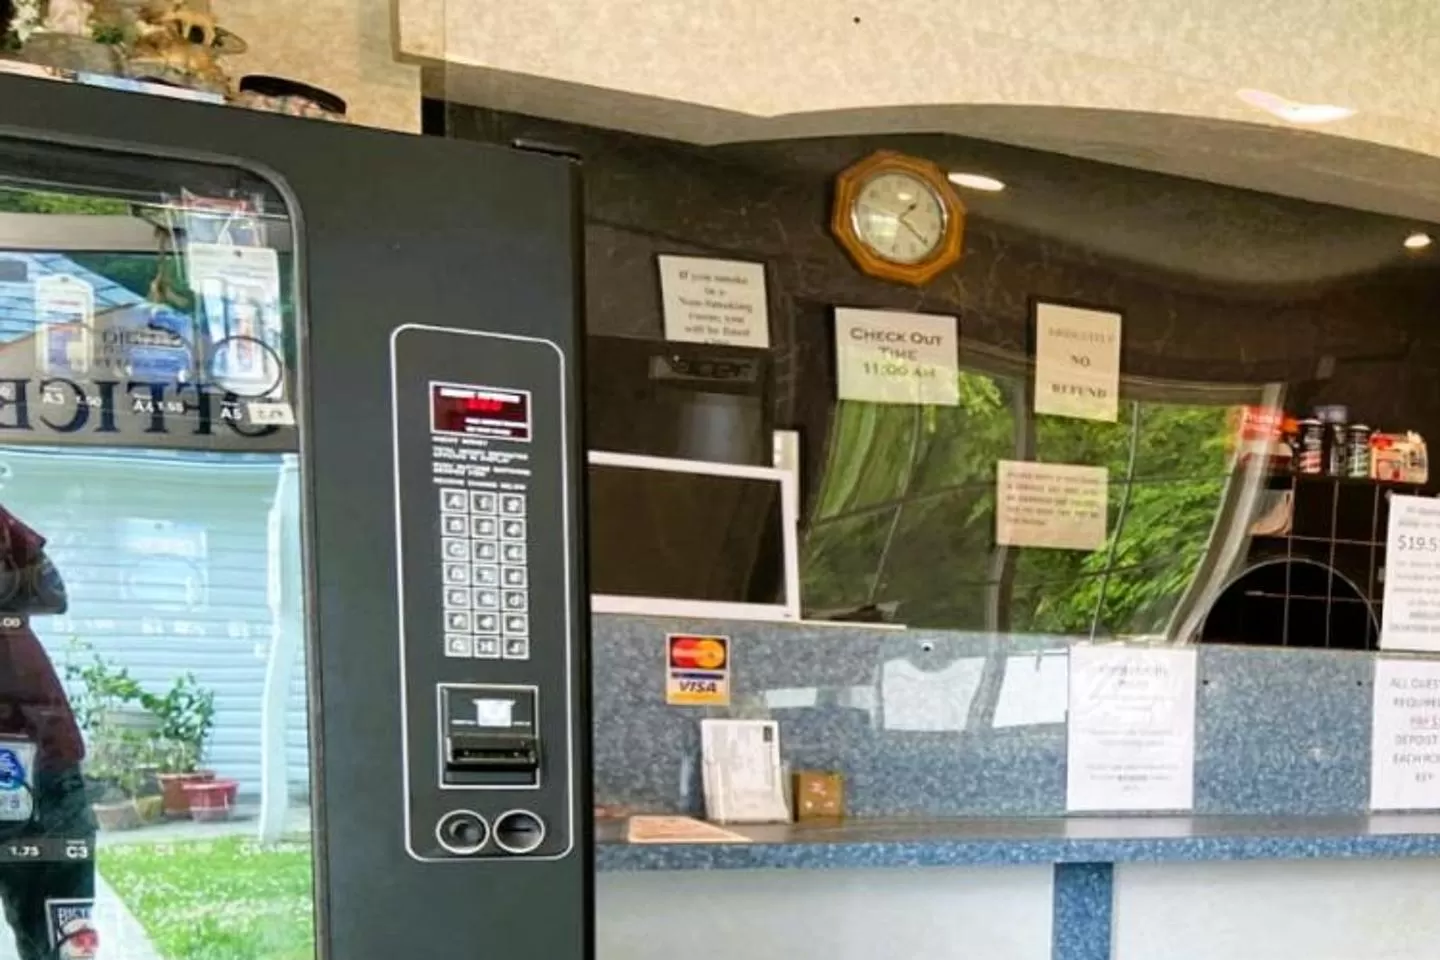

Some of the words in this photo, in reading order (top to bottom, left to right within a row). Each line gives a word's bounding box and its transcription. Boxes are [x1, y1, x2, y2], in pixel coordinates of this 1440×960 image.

[849, 327, 905, 343] CHECK
[910, 331, 943, 346] OUT
[878, 345, 918, 361] TIME
[1070, 354, 1091, 368] NO
[863, 362, 908, 376] 11:00
[1051, 383, 1107, 398] REFUND
[678, 681, 717, 693] VISA
[1390, 678, 1408, 689] ALL
